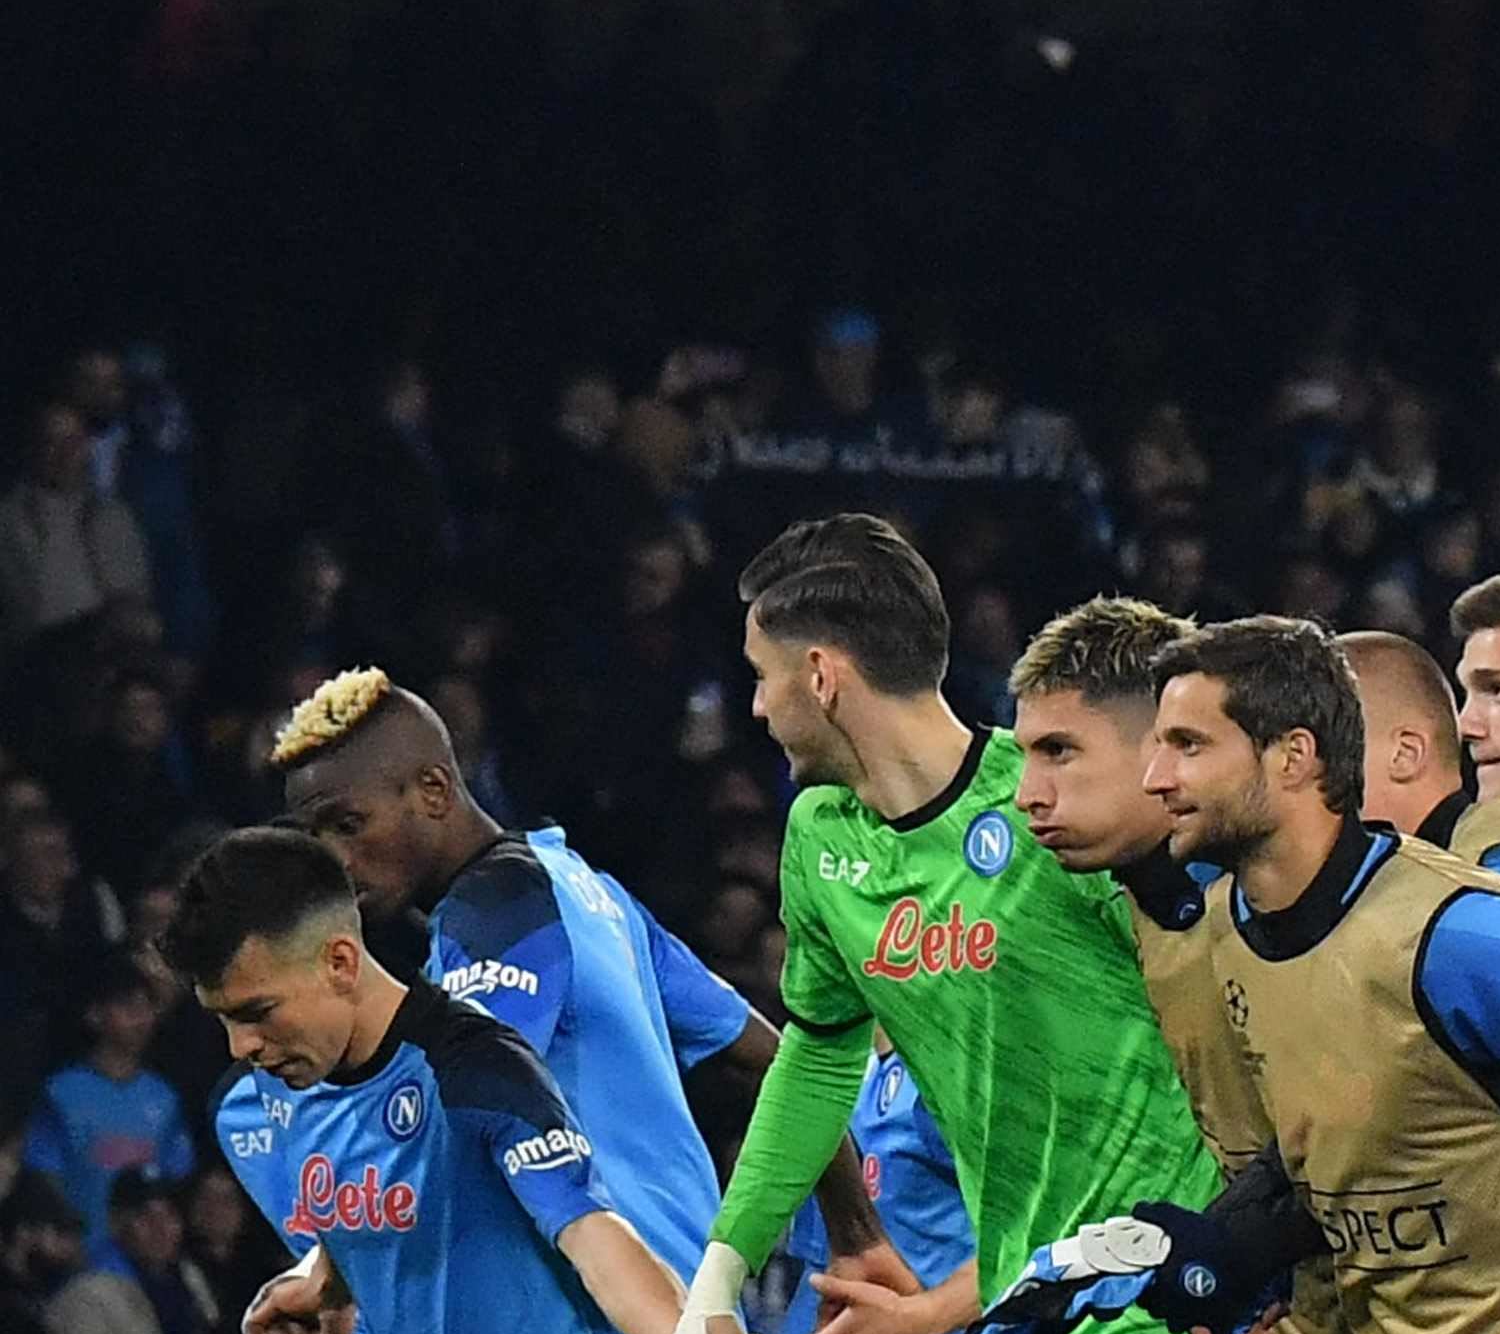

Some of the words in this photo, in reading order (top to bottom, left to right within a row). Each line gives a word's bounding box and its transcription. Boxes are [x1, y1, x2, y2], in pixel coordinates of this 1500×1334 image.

[819, 850, 871, 888] EA7
[861, 896, 998, 982] Lete
[442, 959, 539, 1001] mazon
[502, 1127, 593, 1175] amazo
[283, 1151, 417, 1234] Lete
[1321, 1198, 1449, 1257] SPECT
